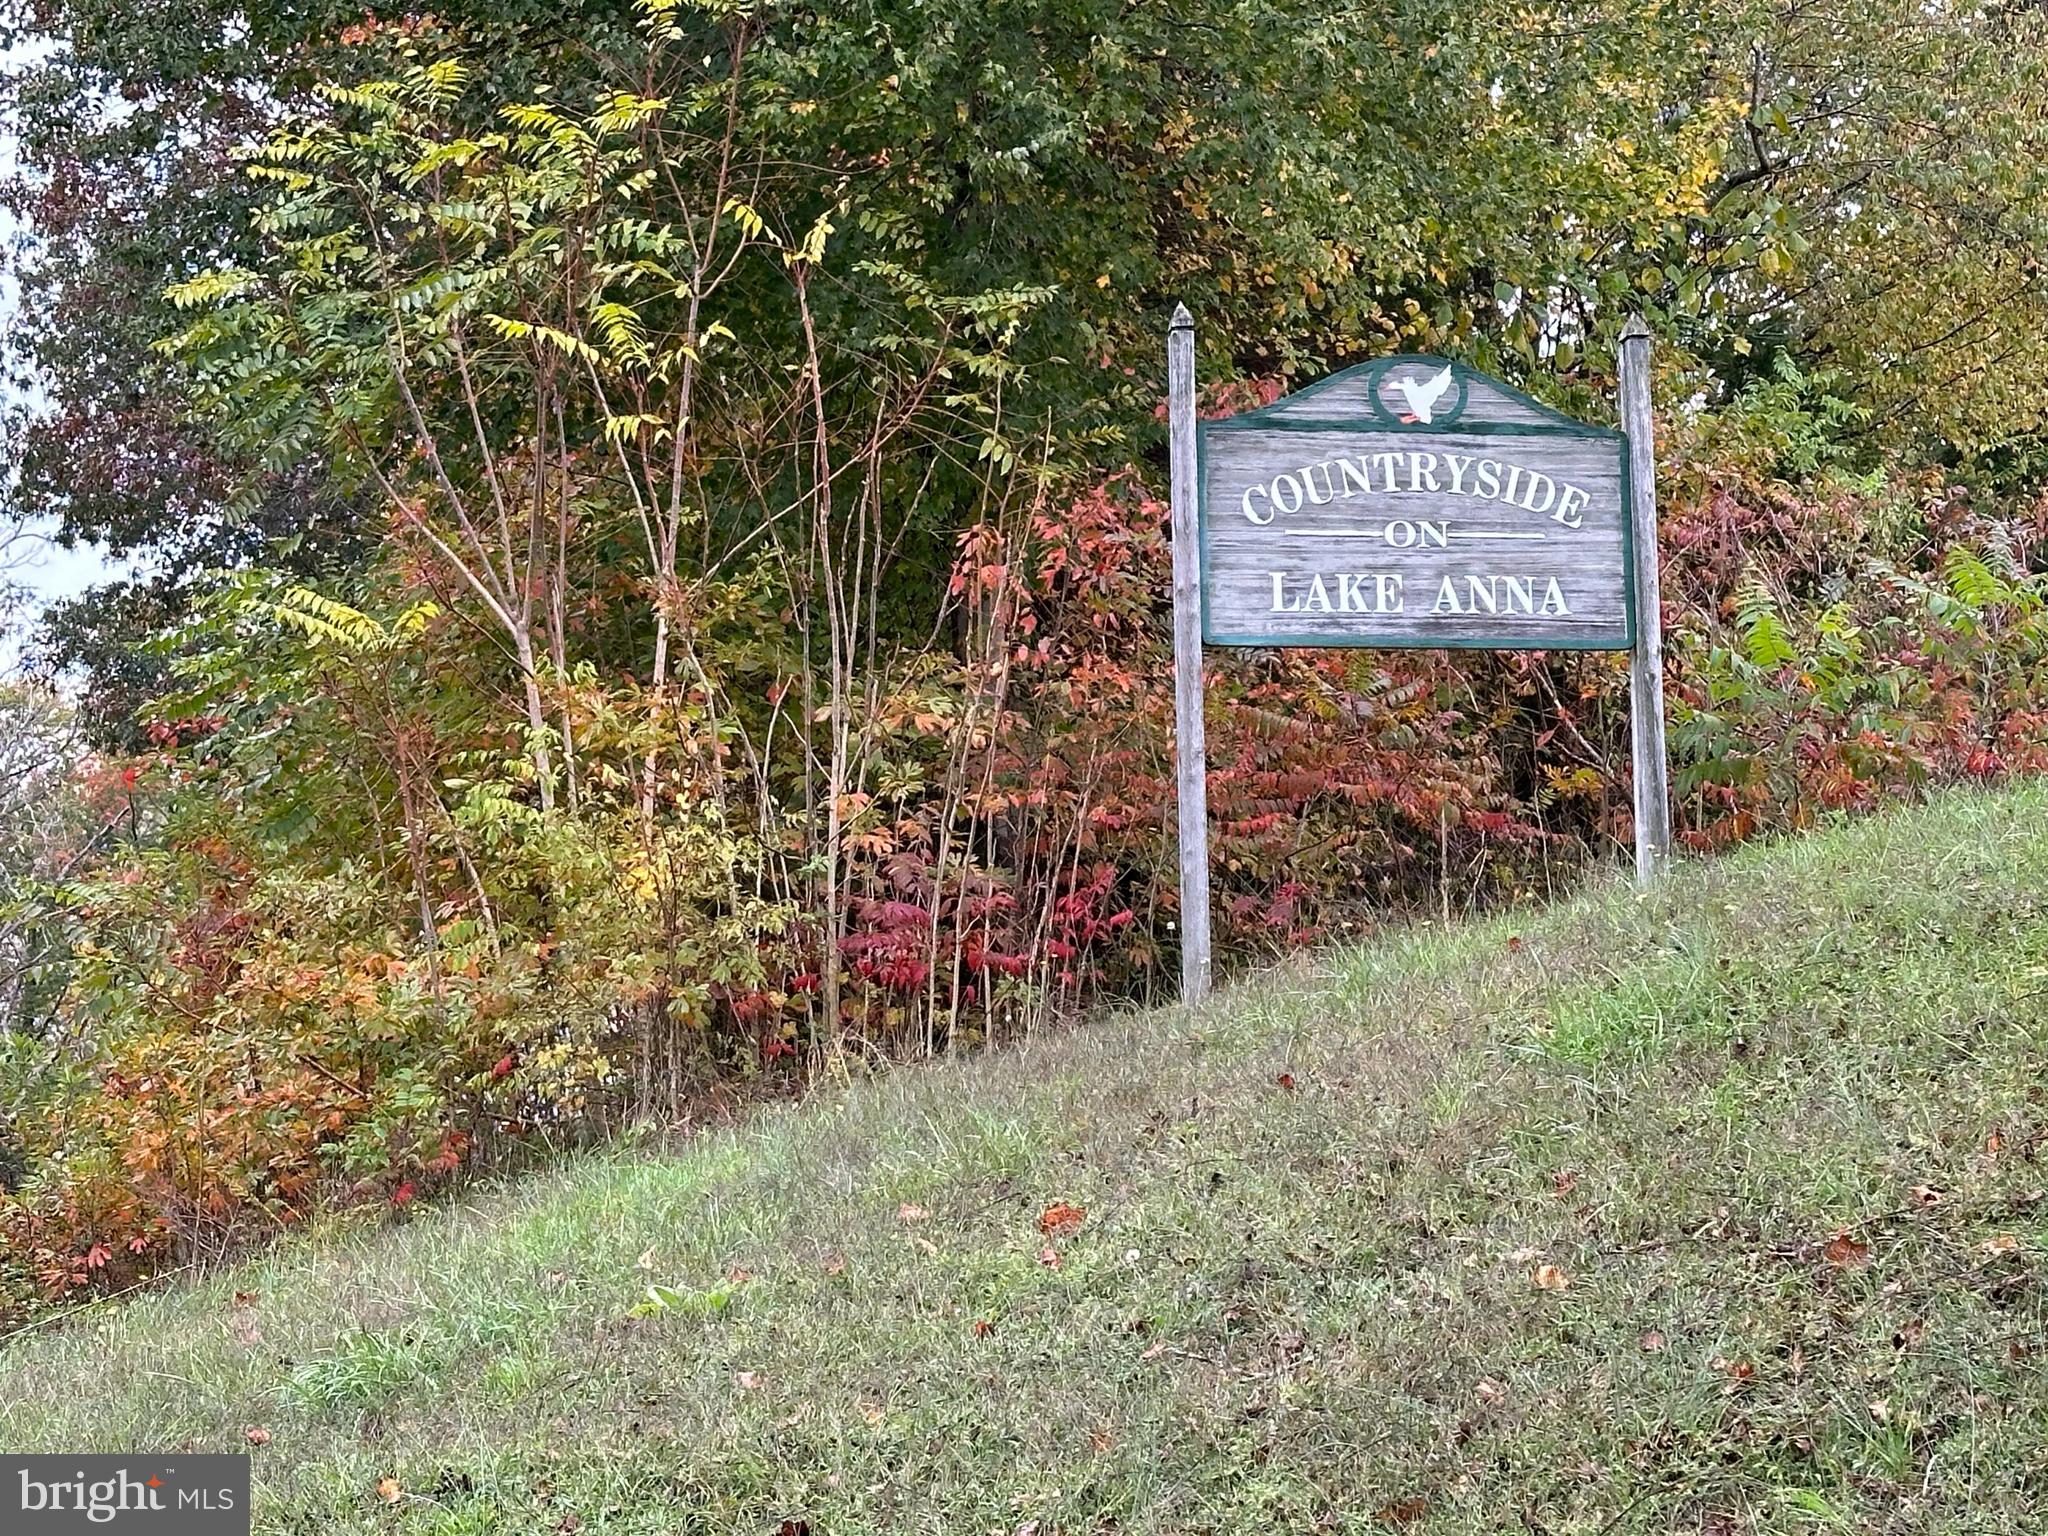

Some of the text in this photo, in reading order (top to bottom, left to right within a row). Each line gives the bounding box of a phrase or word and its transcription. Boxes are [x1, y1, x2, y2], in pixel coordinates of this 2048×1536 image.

[1241, 452, 1592, 529] COUNTRYSIDE
[1384, 520, 1451, 548] ON
[1269, 571, 1572, 616] LAKE ANNA
